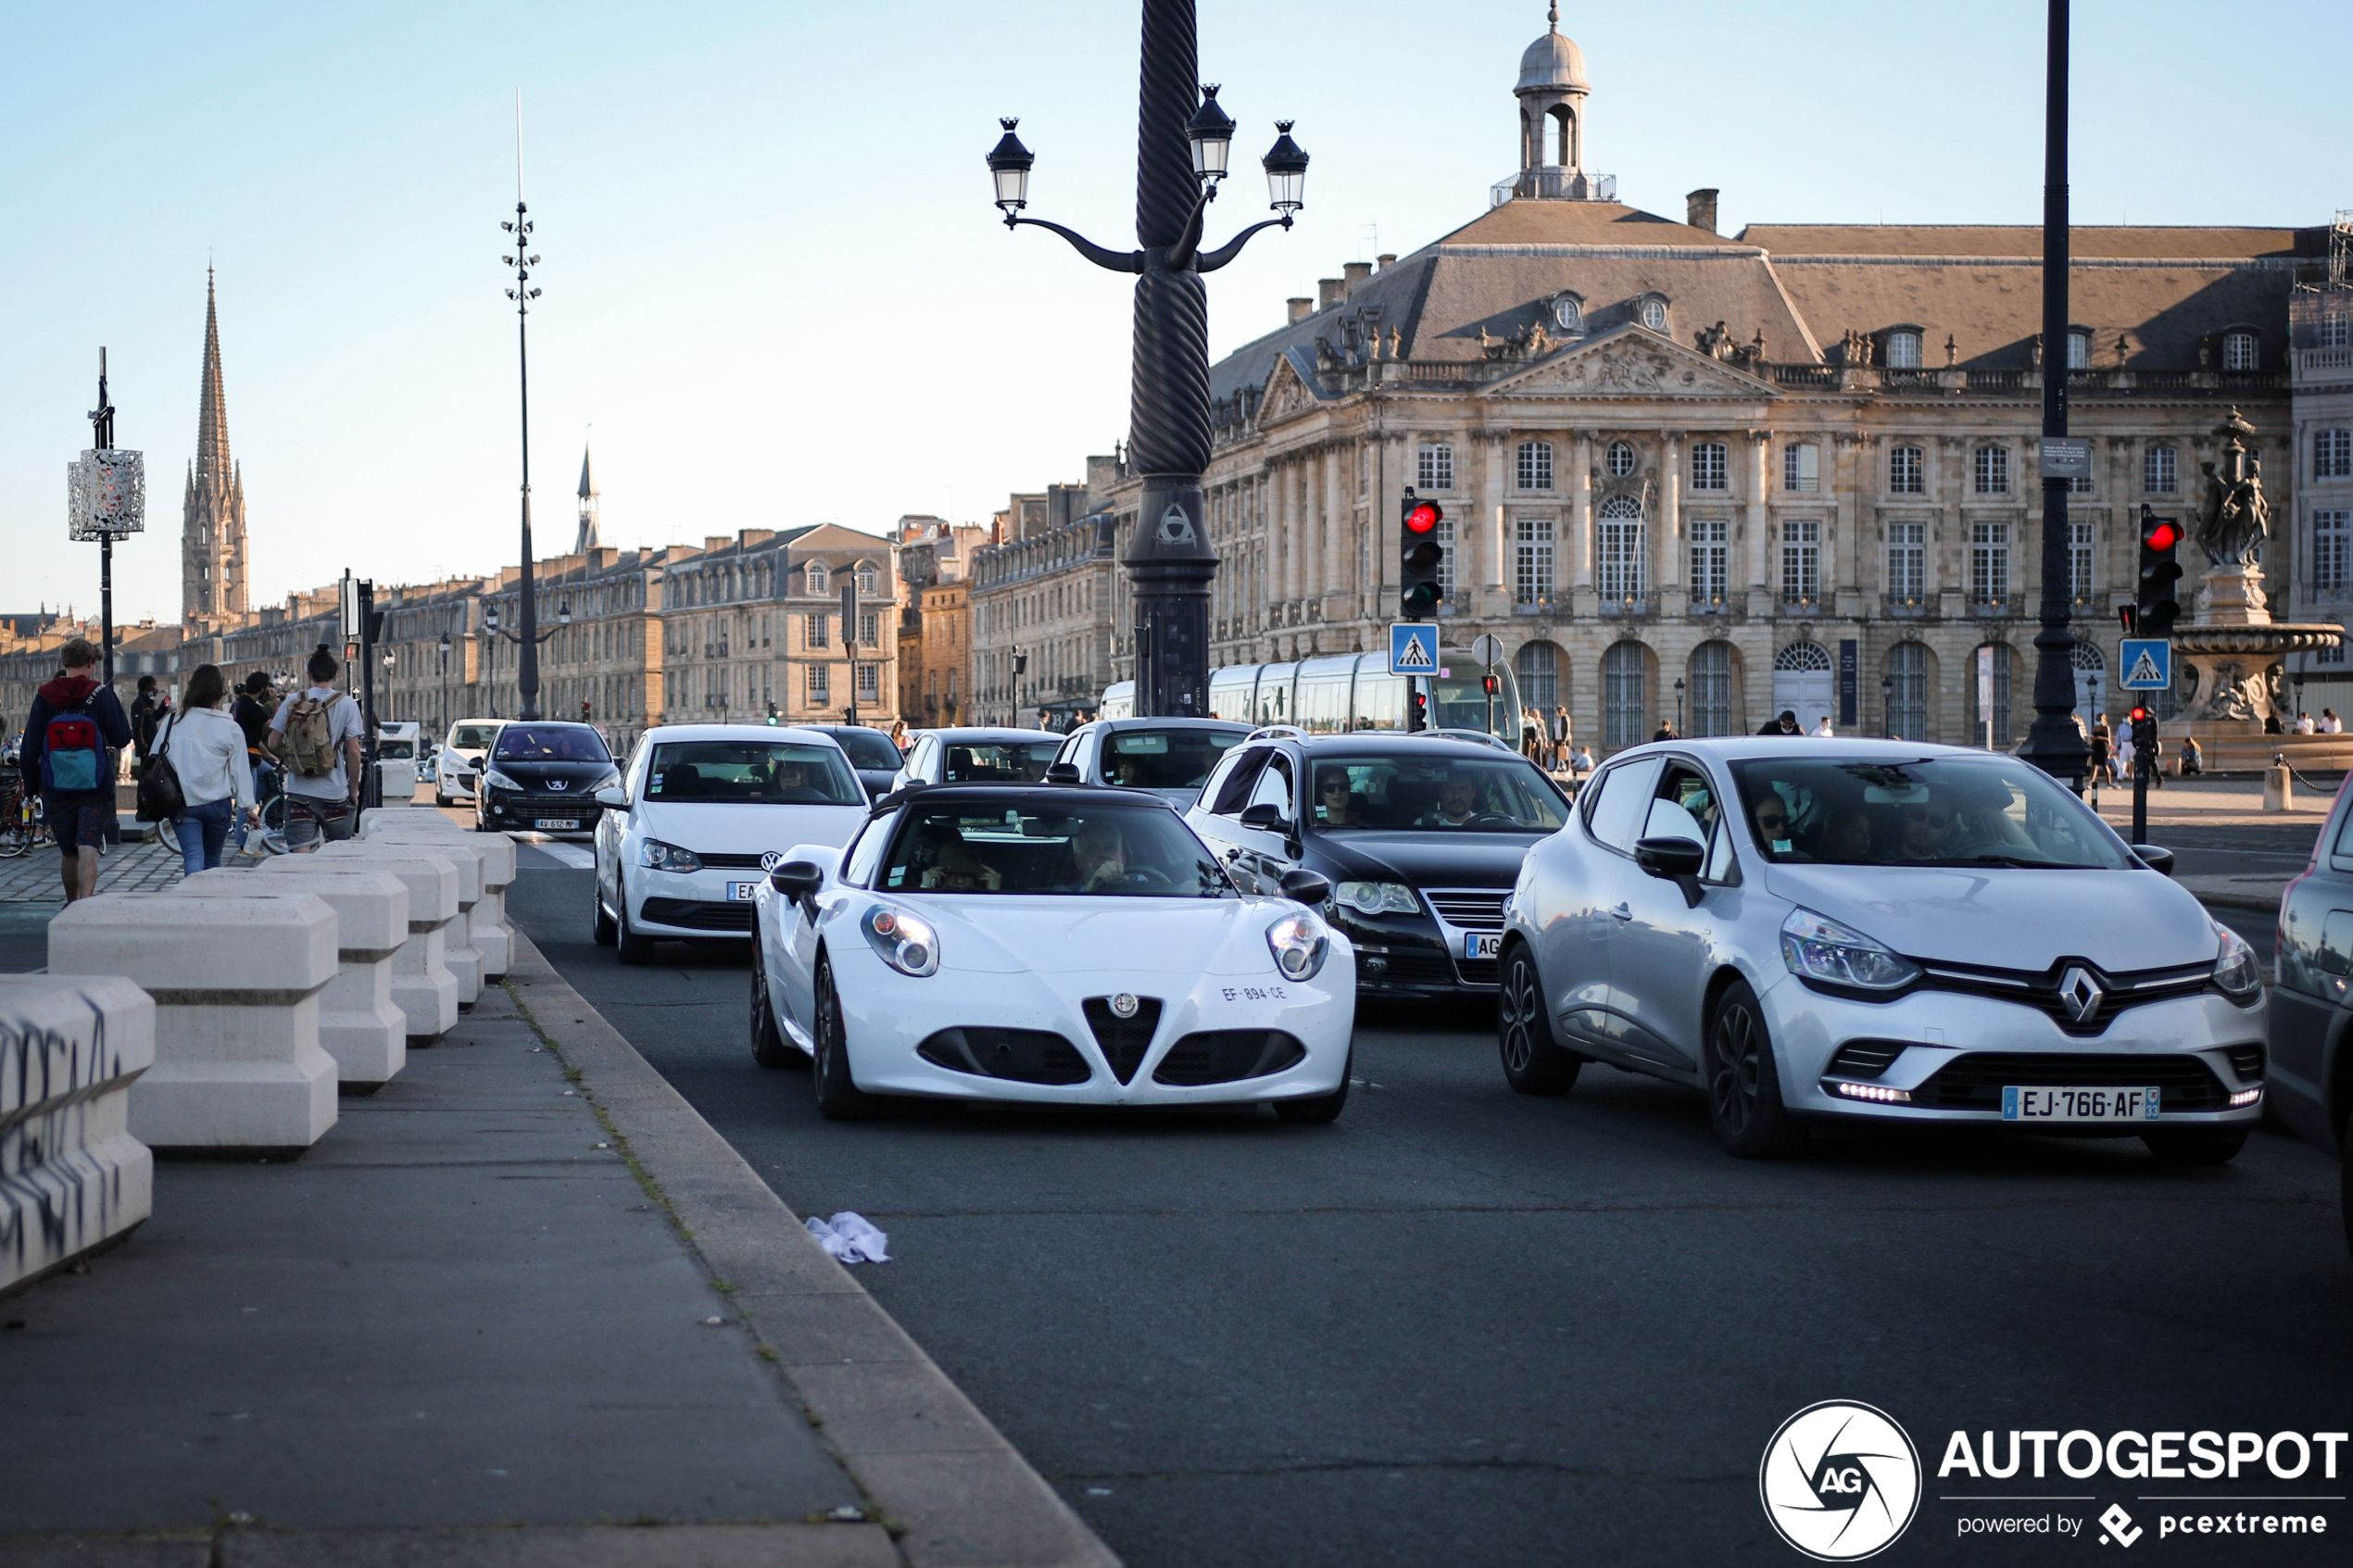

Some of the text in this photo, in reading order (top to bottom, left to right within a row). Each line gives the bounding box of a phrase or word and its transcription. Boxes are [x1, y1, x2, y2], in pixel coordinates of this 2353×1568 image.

[1478, 938, 1500, 955] AG
[2007, 1091, 2158, 1117] F EJ-766-AF 33
